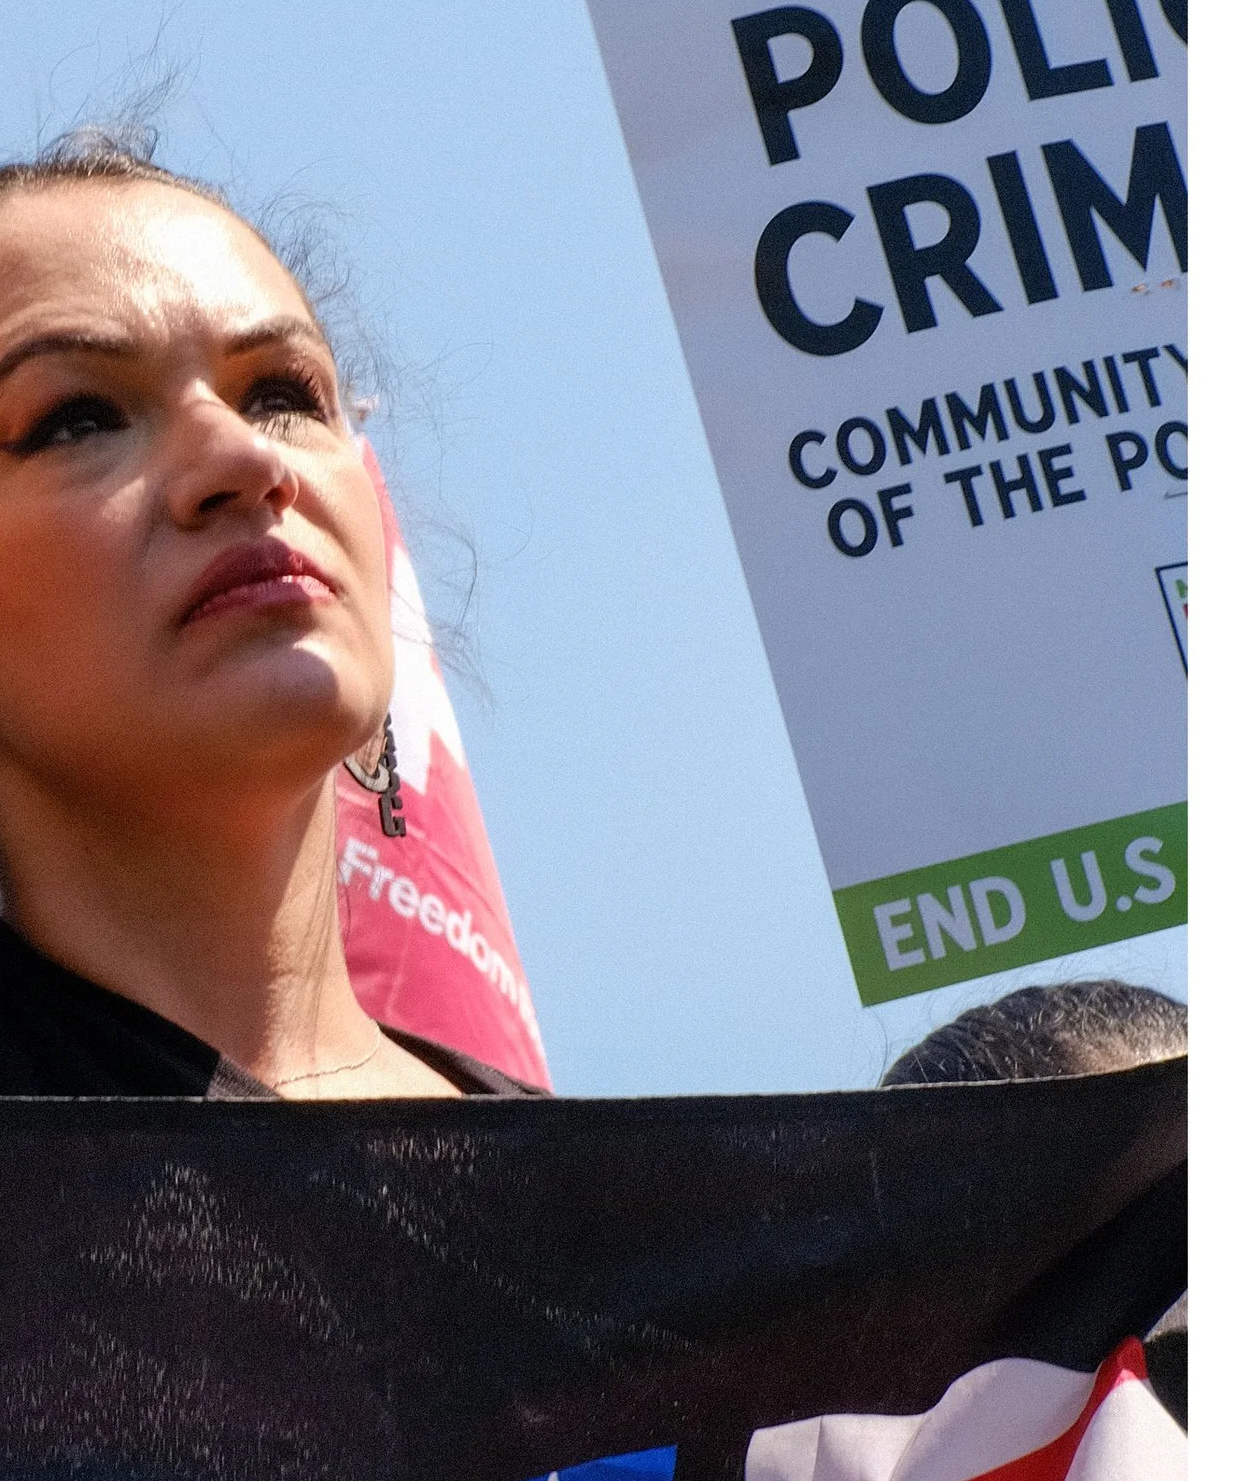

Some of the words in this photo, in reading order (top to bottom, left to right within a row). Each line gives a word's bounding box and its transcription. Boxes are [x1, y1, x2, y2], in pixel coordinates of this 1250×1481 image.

[754, 122, 1187, 357] CRIM
[827, 482, 914, 558] OF
[944, 442, 1087, 528] THE
[339, 837, 520, 1007] Freedom
[873, 876, 1026, 971] END
[1050, 836, 1176, 922] U.S
